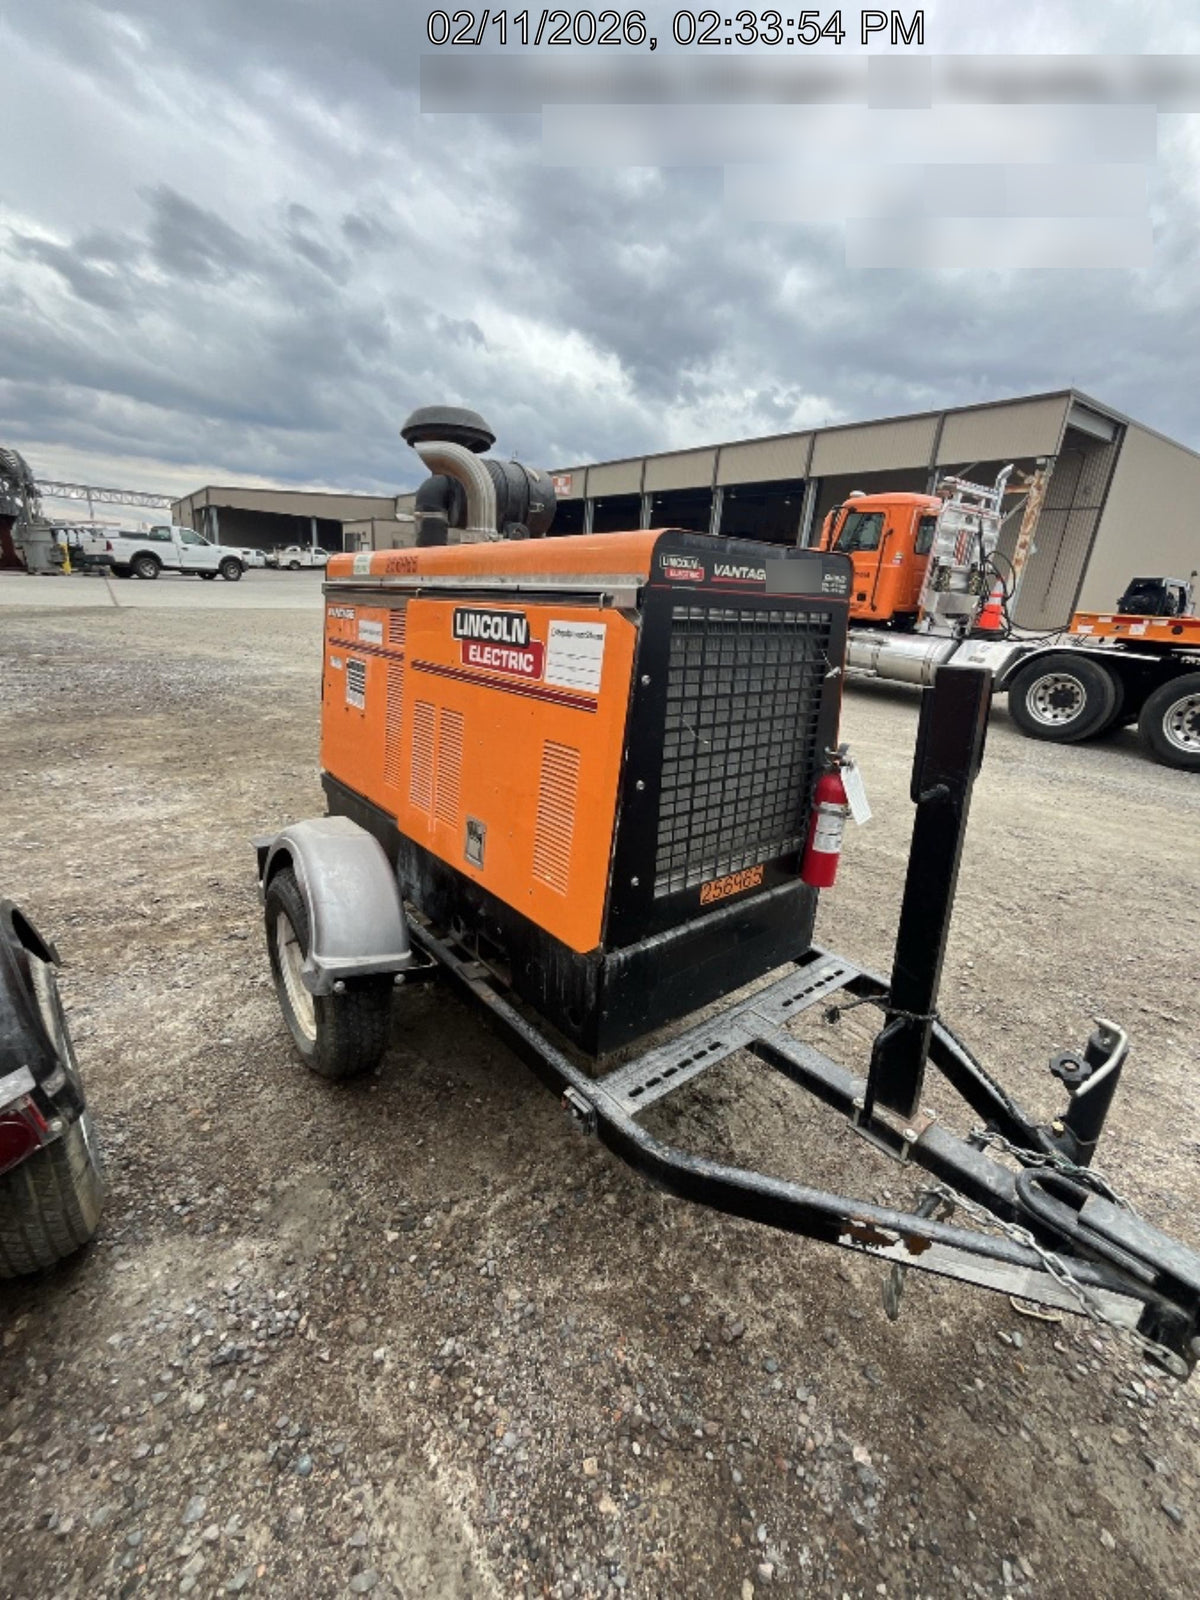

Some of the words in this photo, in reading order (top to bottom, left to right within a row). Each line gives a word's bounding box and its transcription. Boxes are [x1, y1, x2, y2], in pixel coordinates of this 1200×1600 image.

[662, 556, 700, 569] LINCOLN
[713, 563, 767, 580] VANTAG
[455, 612, 527, 644] LINCOLN
[468, 644, 535, 673] ELECTRIC
